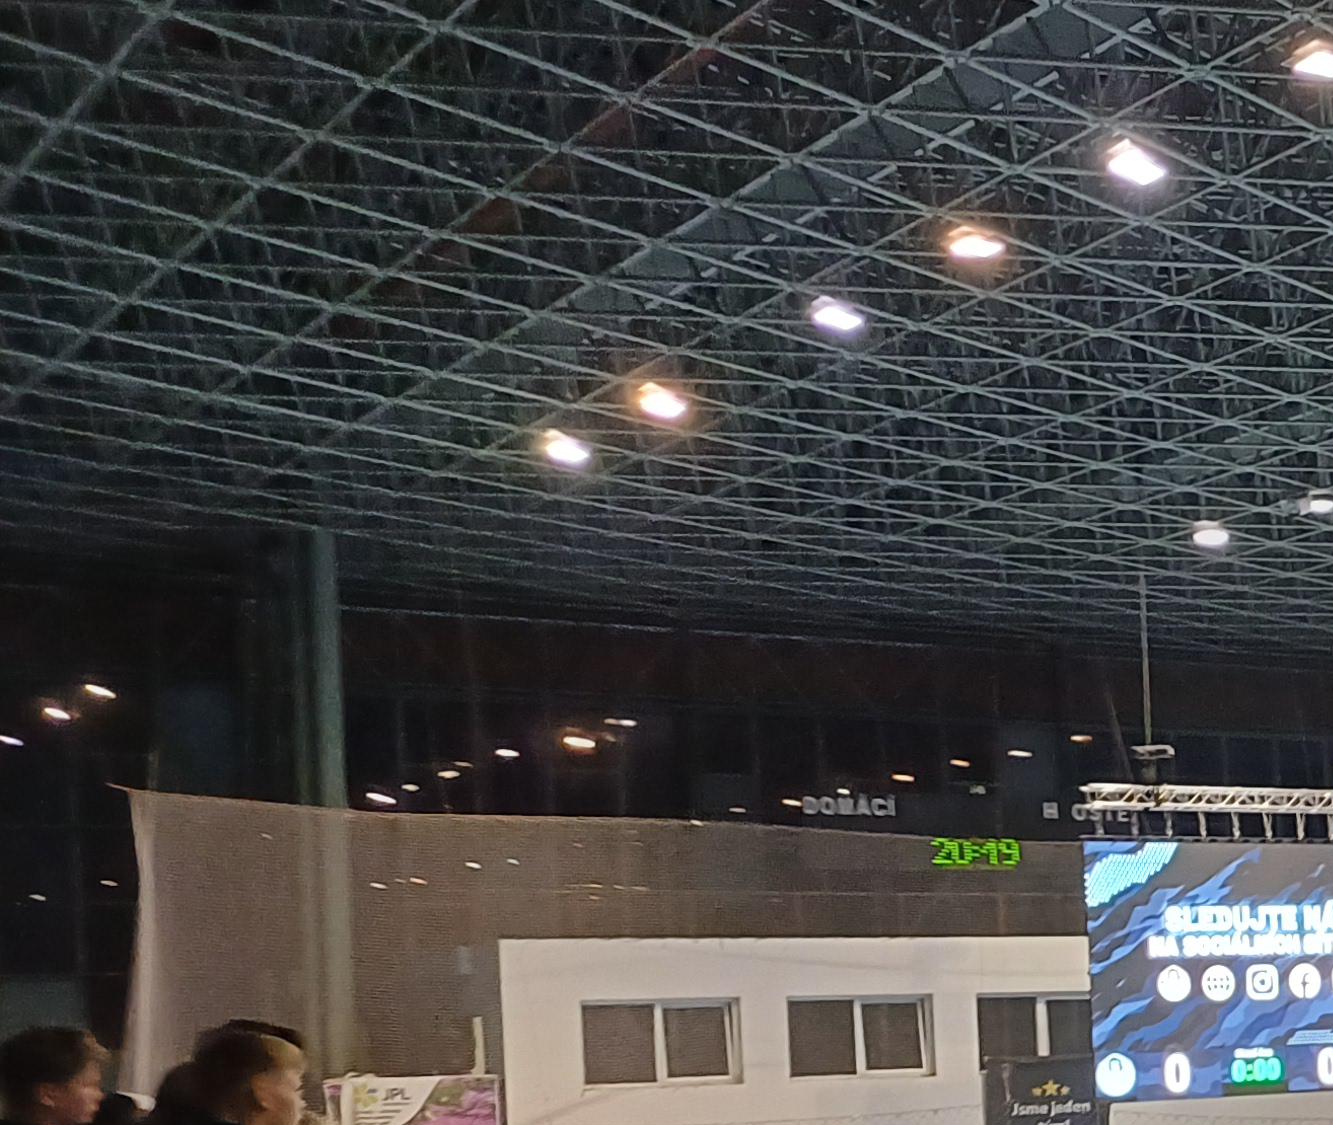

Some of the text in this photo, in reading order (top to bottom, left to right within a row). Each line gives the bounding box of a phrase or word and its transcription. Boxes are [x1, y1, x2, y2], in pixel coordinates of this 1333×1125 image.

[1165, 904, 1298, 932] SLEDUJTE
[1163, 1052, 1191, 1093] 0
[1231, 1057, 1282, 1083] 0:00
[1011, 1099, 1090, 1117] Jsme jeden
